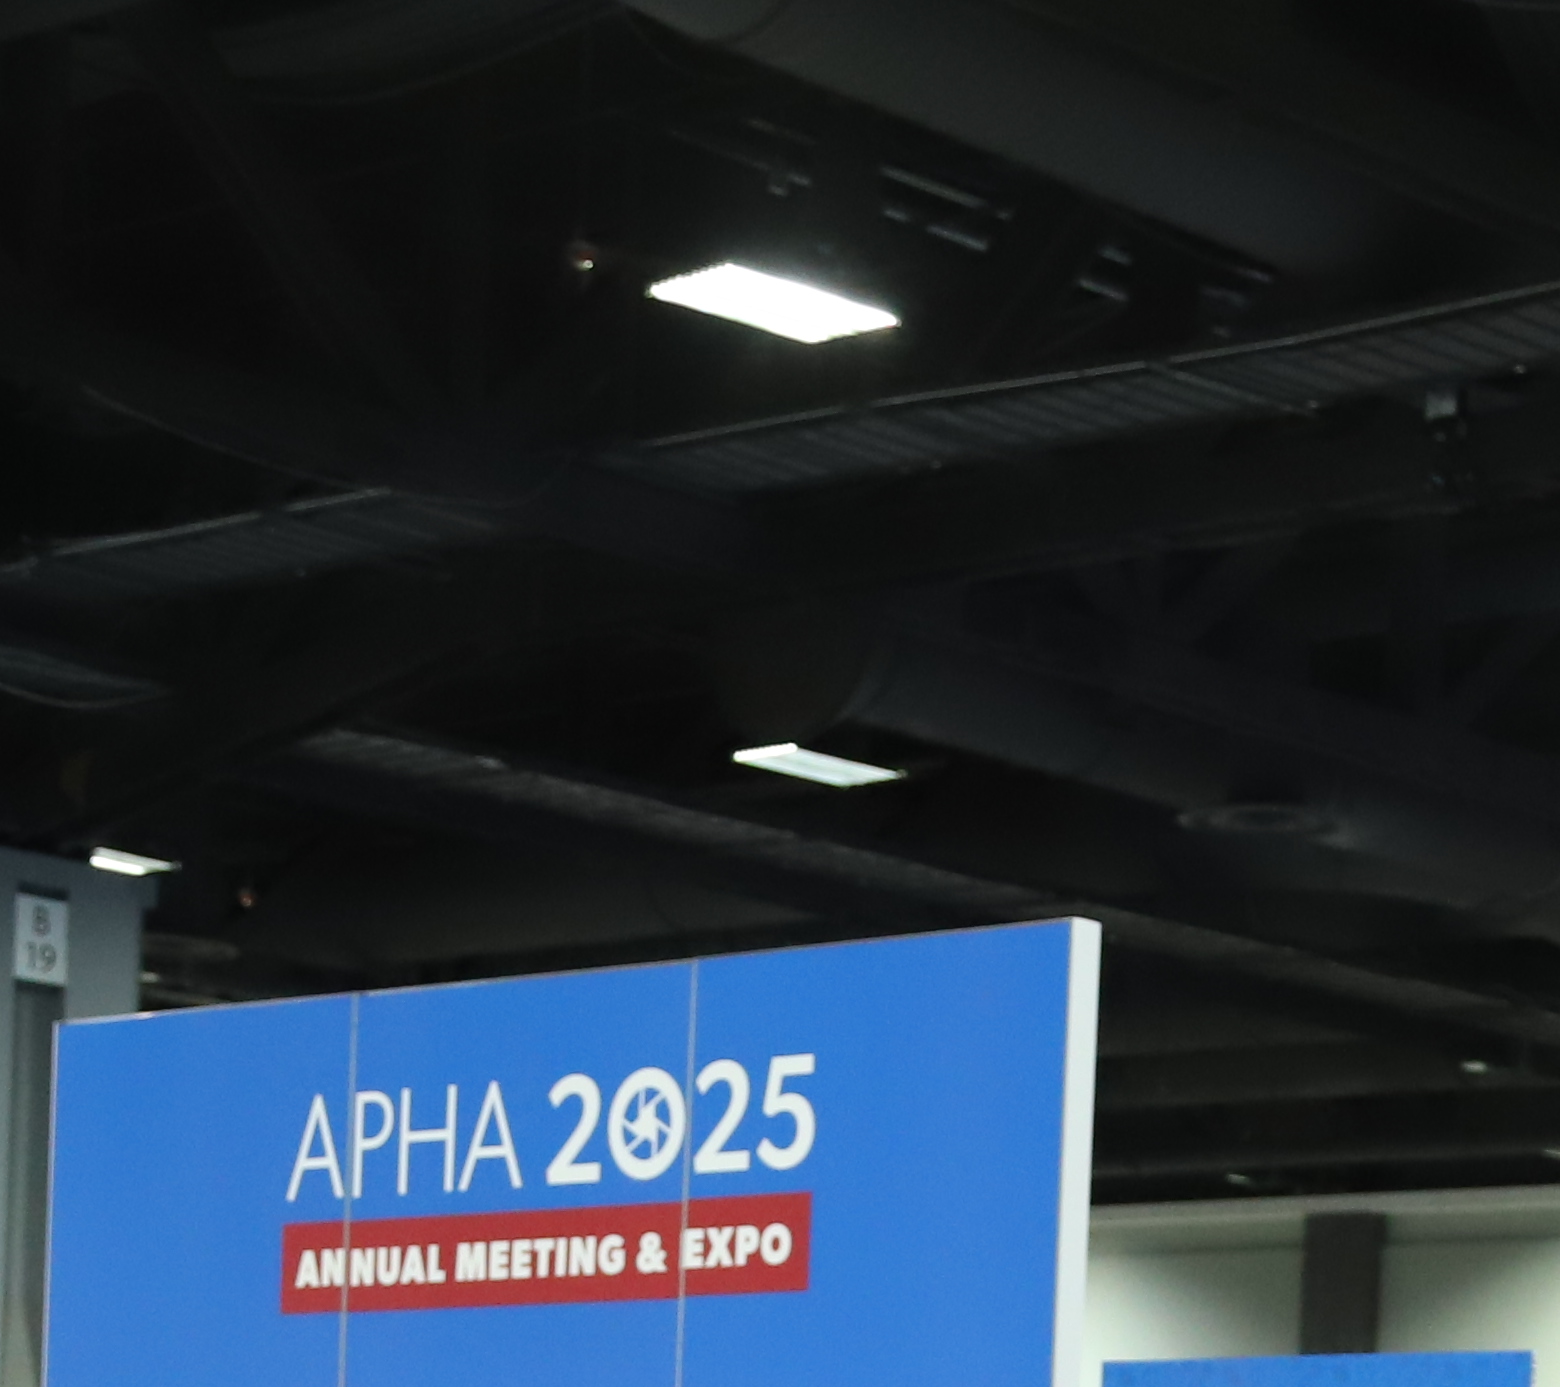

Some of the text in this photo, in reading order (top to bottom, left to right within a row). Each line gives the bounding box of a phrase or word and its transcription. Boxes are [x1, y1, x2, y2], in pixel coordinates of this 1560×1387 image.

[285, 1053, 817, 1202] APHA 2025
[294, 1222, 793, 1290] ANNUAL MEETING & EXPO
